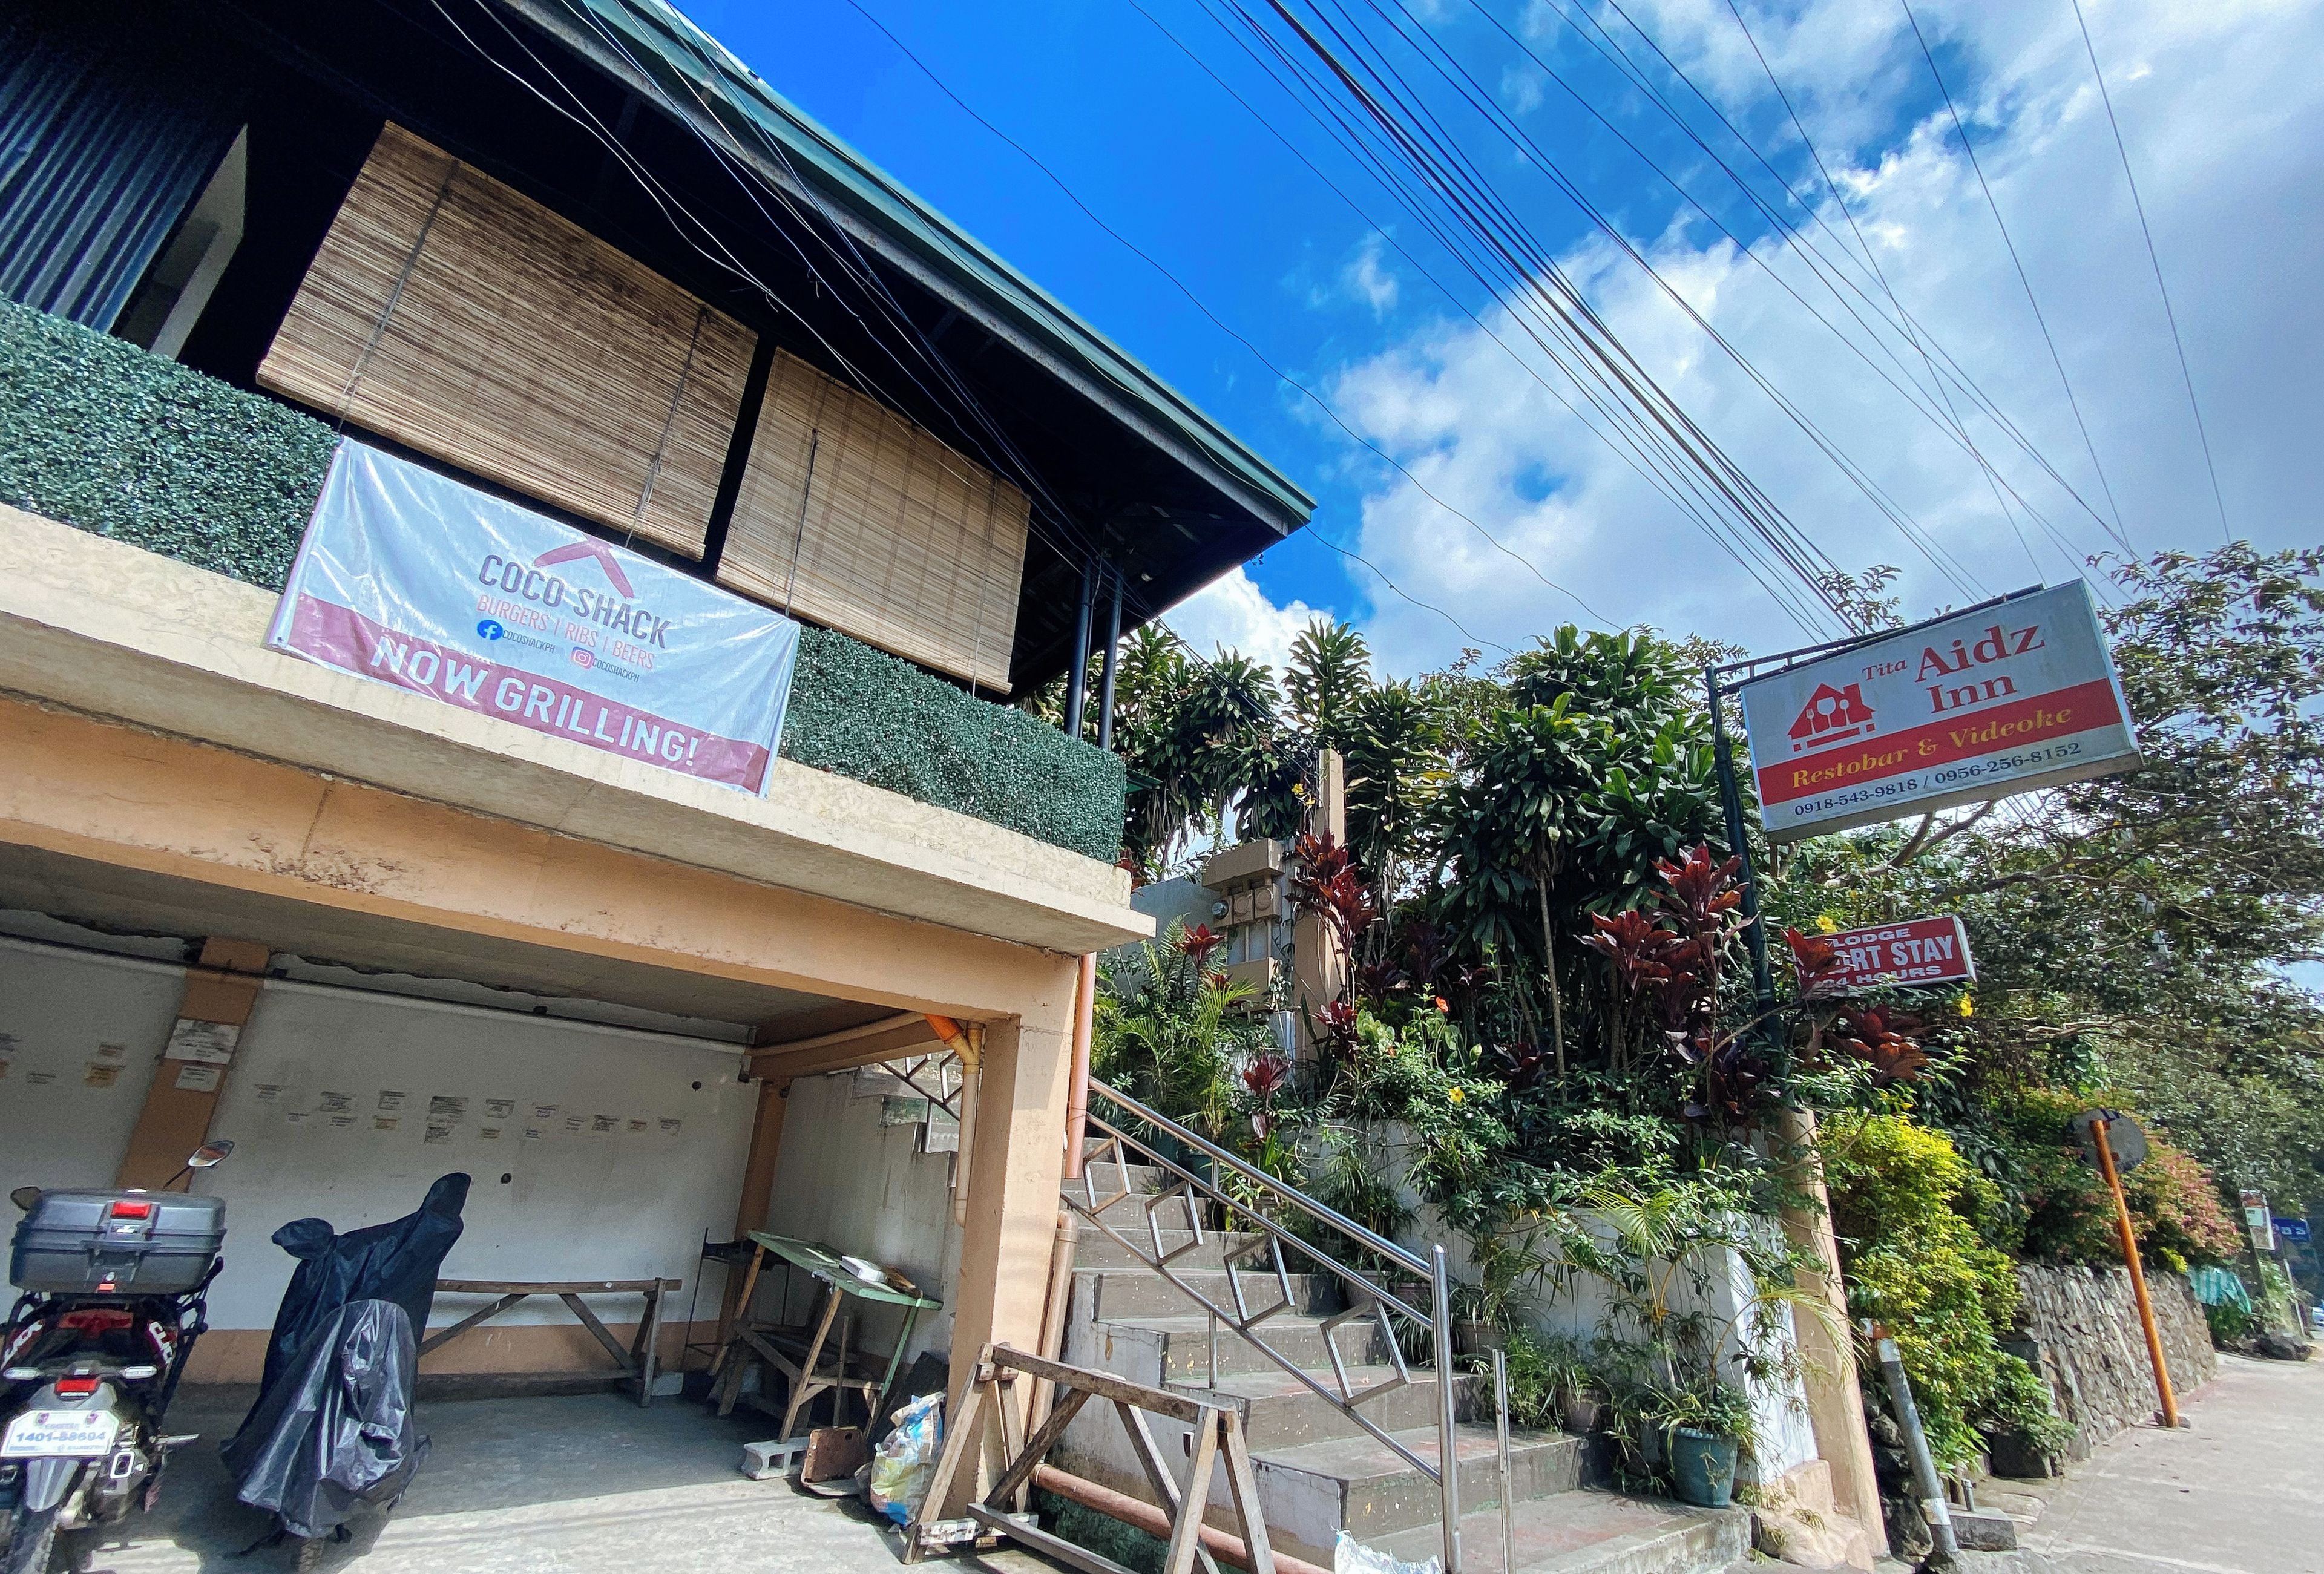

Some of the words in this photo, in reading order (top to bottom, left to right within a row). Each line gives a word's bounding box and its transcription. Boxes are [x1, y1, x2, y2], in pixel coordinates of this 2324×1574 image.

[479, 554, 565, 607] COCO
[573, 588, 672, 649] SHACK
[477, 594, 549, 631] BURGERS
[564, 621, 599, 648] RIBS
[612, 640, 655, 669] BEERS
[502, 630, 556, 654] COCOSHACKPH
[1862, 660, 1907, 681] Tita
[1914, 625, 2045, 683] Aidz
[592, 658, 640, 683] COCOSHACKPH
[1926, 675, 2018, 713] Inn
[370, 635, 488, 701] NOW
[494, 677, 699, 766] GRILLING!
[1792, 747, 1908, 789] Restobar
[1917, 738, 1938, 756] &
[1948, 708, 2072, 748] Videoke
[1794, 778, 1917, 816] 0918-543-9818
[1935, 742, 2081, 784] 0956-256-8152
[1833, 928, 1911, 948] LODGE
[1890, 935, 1953, 966] STAY
